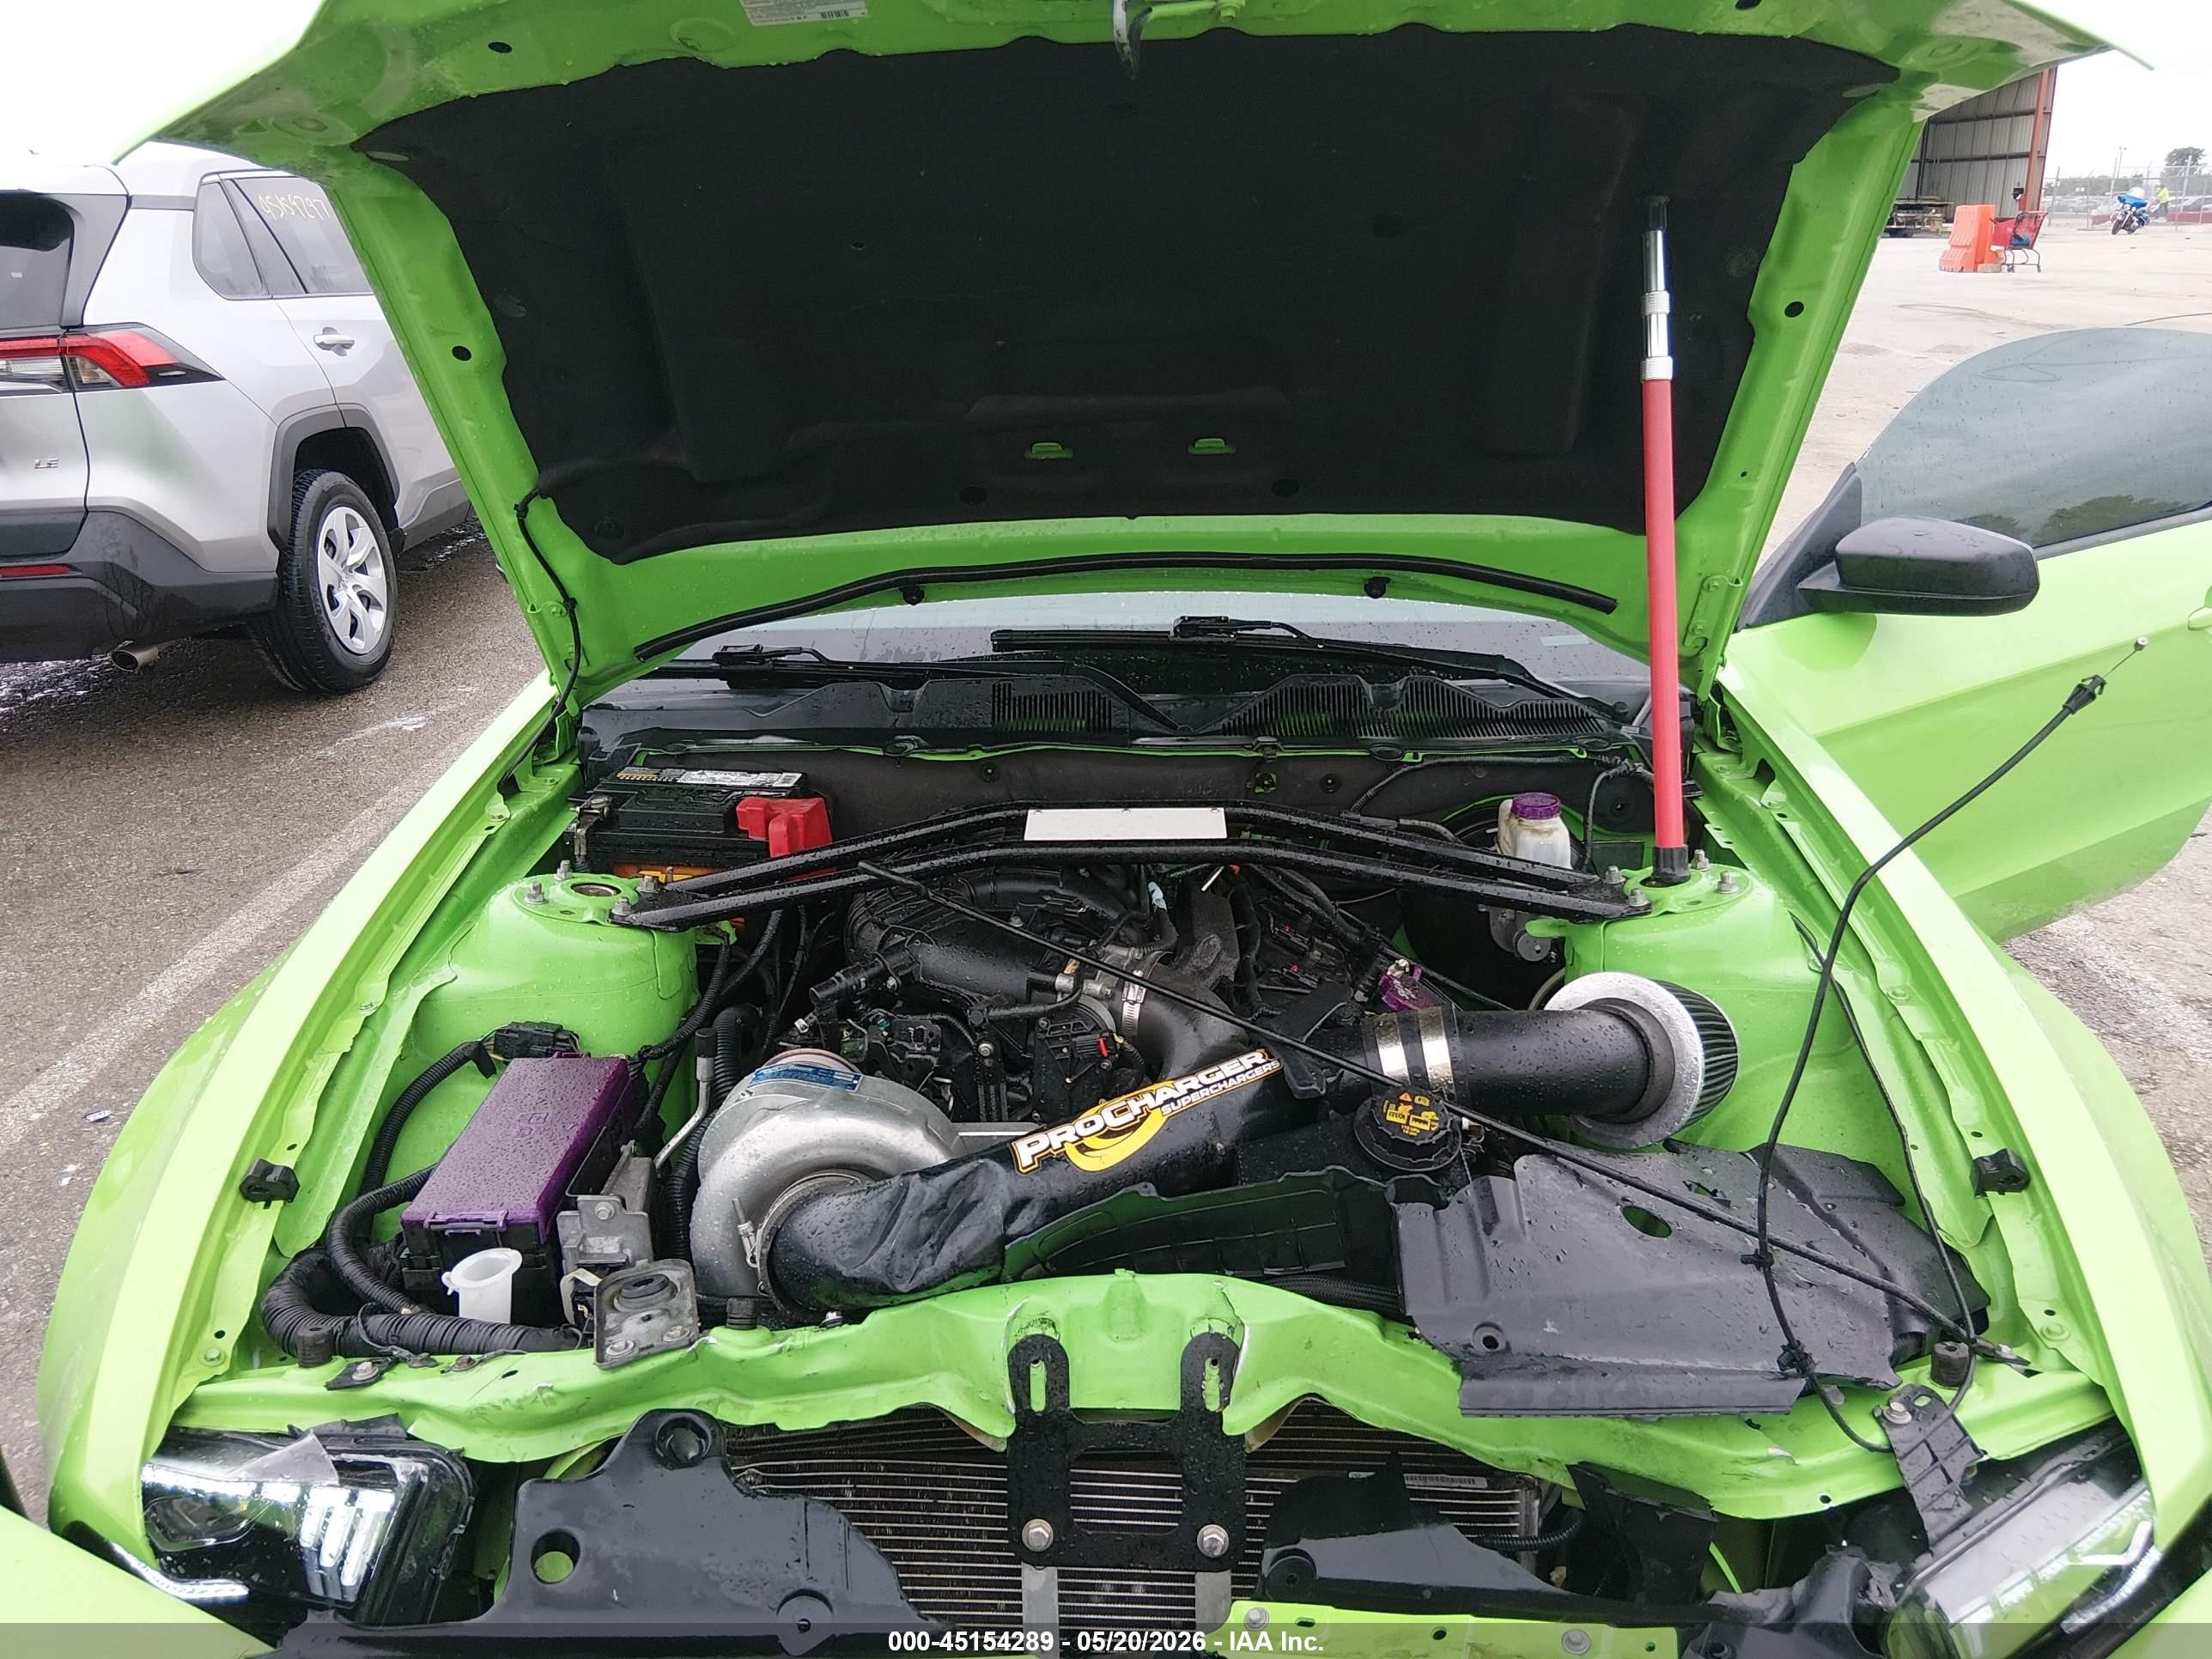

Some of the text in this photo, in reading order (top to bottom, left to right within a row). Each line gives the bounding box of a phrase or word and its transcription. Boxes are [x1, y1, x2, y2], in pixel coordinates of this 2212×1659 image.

[33, 458, 59, 469] LE
[1014, 1049, 1269, 1168] PROCHARGER
[1160, 1060, 1281, 1116] SUPERCHARGERS
